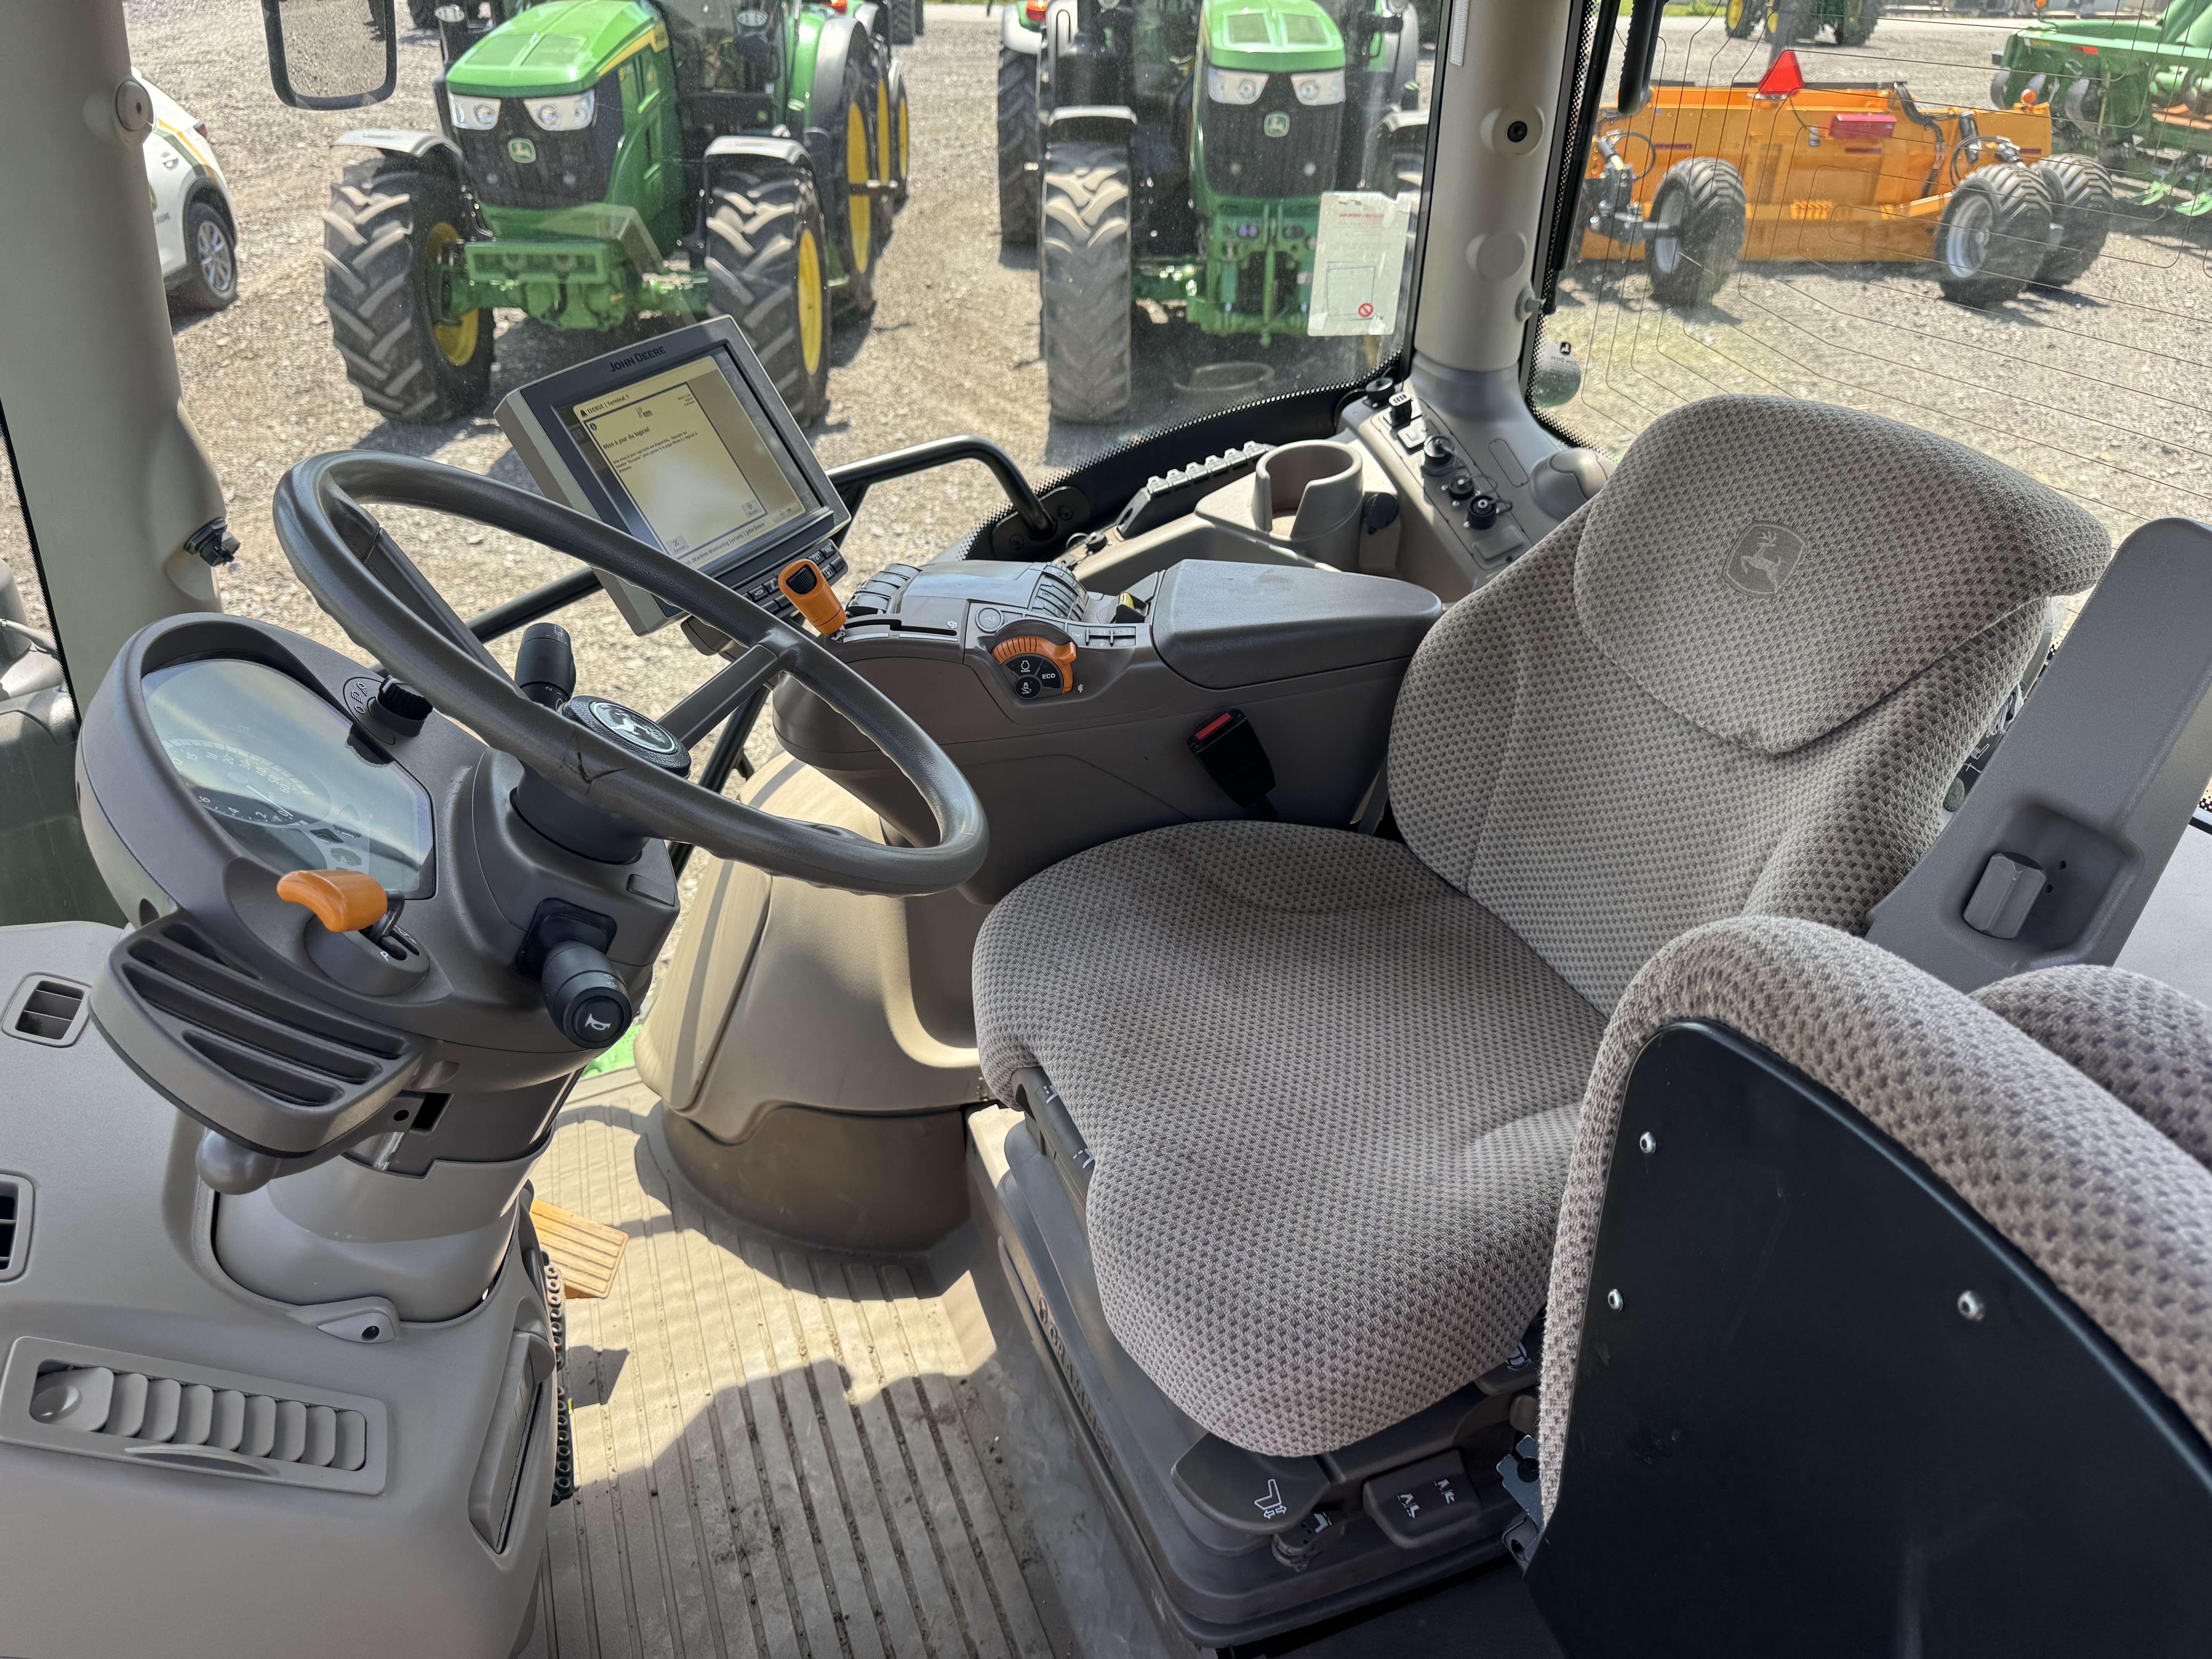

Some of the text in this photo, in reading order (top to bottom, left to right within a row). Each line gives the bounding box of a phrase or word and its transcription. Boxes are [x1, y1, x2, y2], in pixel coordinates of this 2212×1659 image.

[610, 346, 666, 372] JOHN DEERE
[279, 783, 290, 794] 60
[380, 950, 389, 961] P
